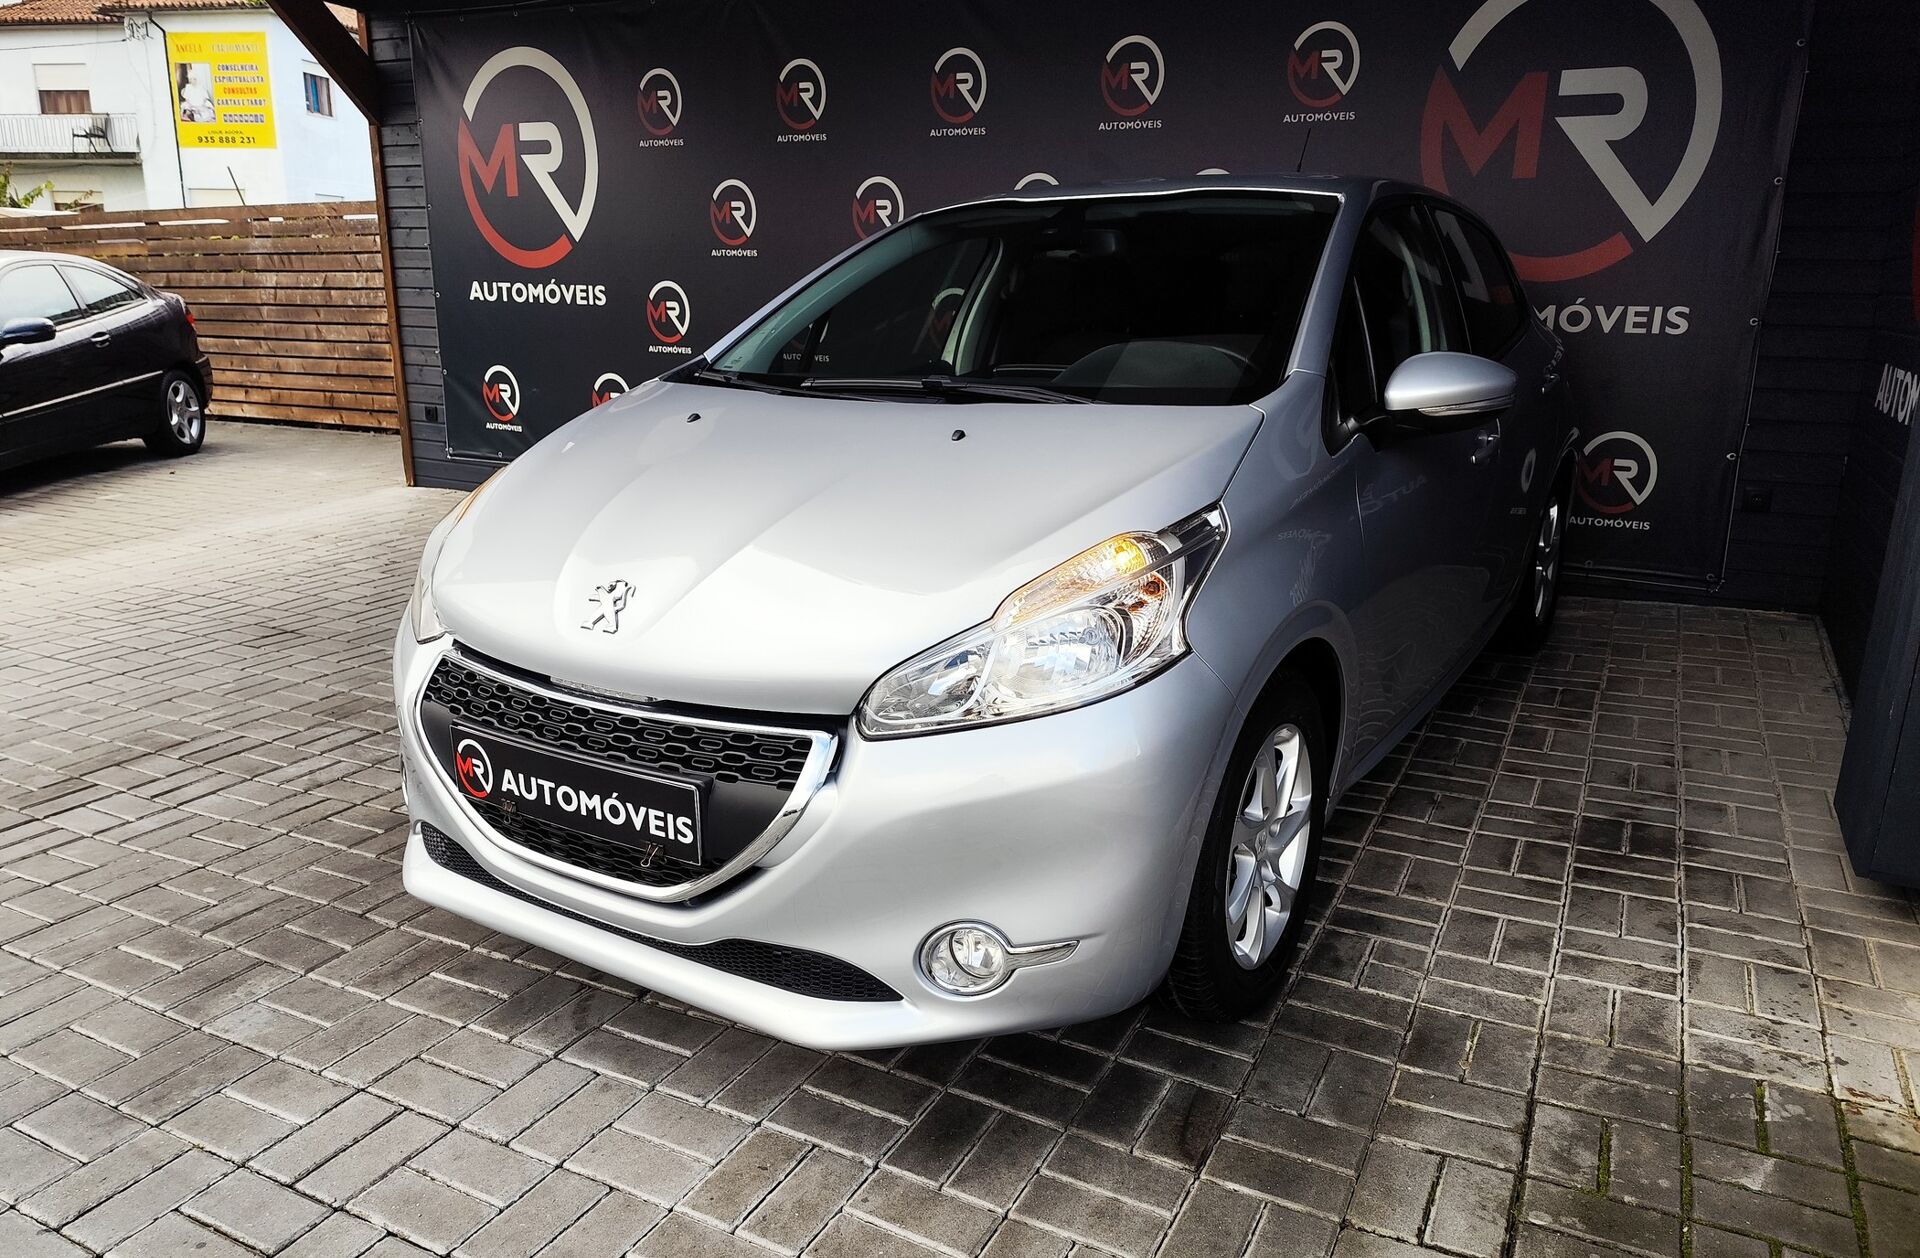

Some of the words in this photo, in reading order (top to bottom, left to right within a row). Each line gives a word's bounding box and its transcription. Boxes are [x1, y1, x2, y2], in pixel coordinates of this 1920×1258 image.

[1283, 110, 1356, 123] AUTOMÓVEIS
[1098, 119, 1162, 131] AUTOMÓVEIS
[777, 132, 827, 142] AUTOMÓVEIS
[930, 126, 986, 137] AUTOMÓVEIS
[197, 136, 215, 144] 935
[218, 136, 236, 144] 888
[240, 136, 256, 144] 231
[639, 138, 684, 148] AUTOMÓVEIS
[711, 248, 758, 257] AUTOMÓVEIS
[469, 278, 607, 306] AUTOMÓVEIS
[1532, 297, 1691, 336] MÓVEIS
[648, 345, 692, 355] AUTOMÓVEIS
[782, 352, 831, 363] AUTOVEIS
[1875, 363, 1920, 426] AUTOM
[485, 422, 523, 433] AUTOMÓVEIS
[1568, 515, 1651, 531] AUTOMÓVEIS
[501, 768, 694, 845] AUTOMÓVEIS
